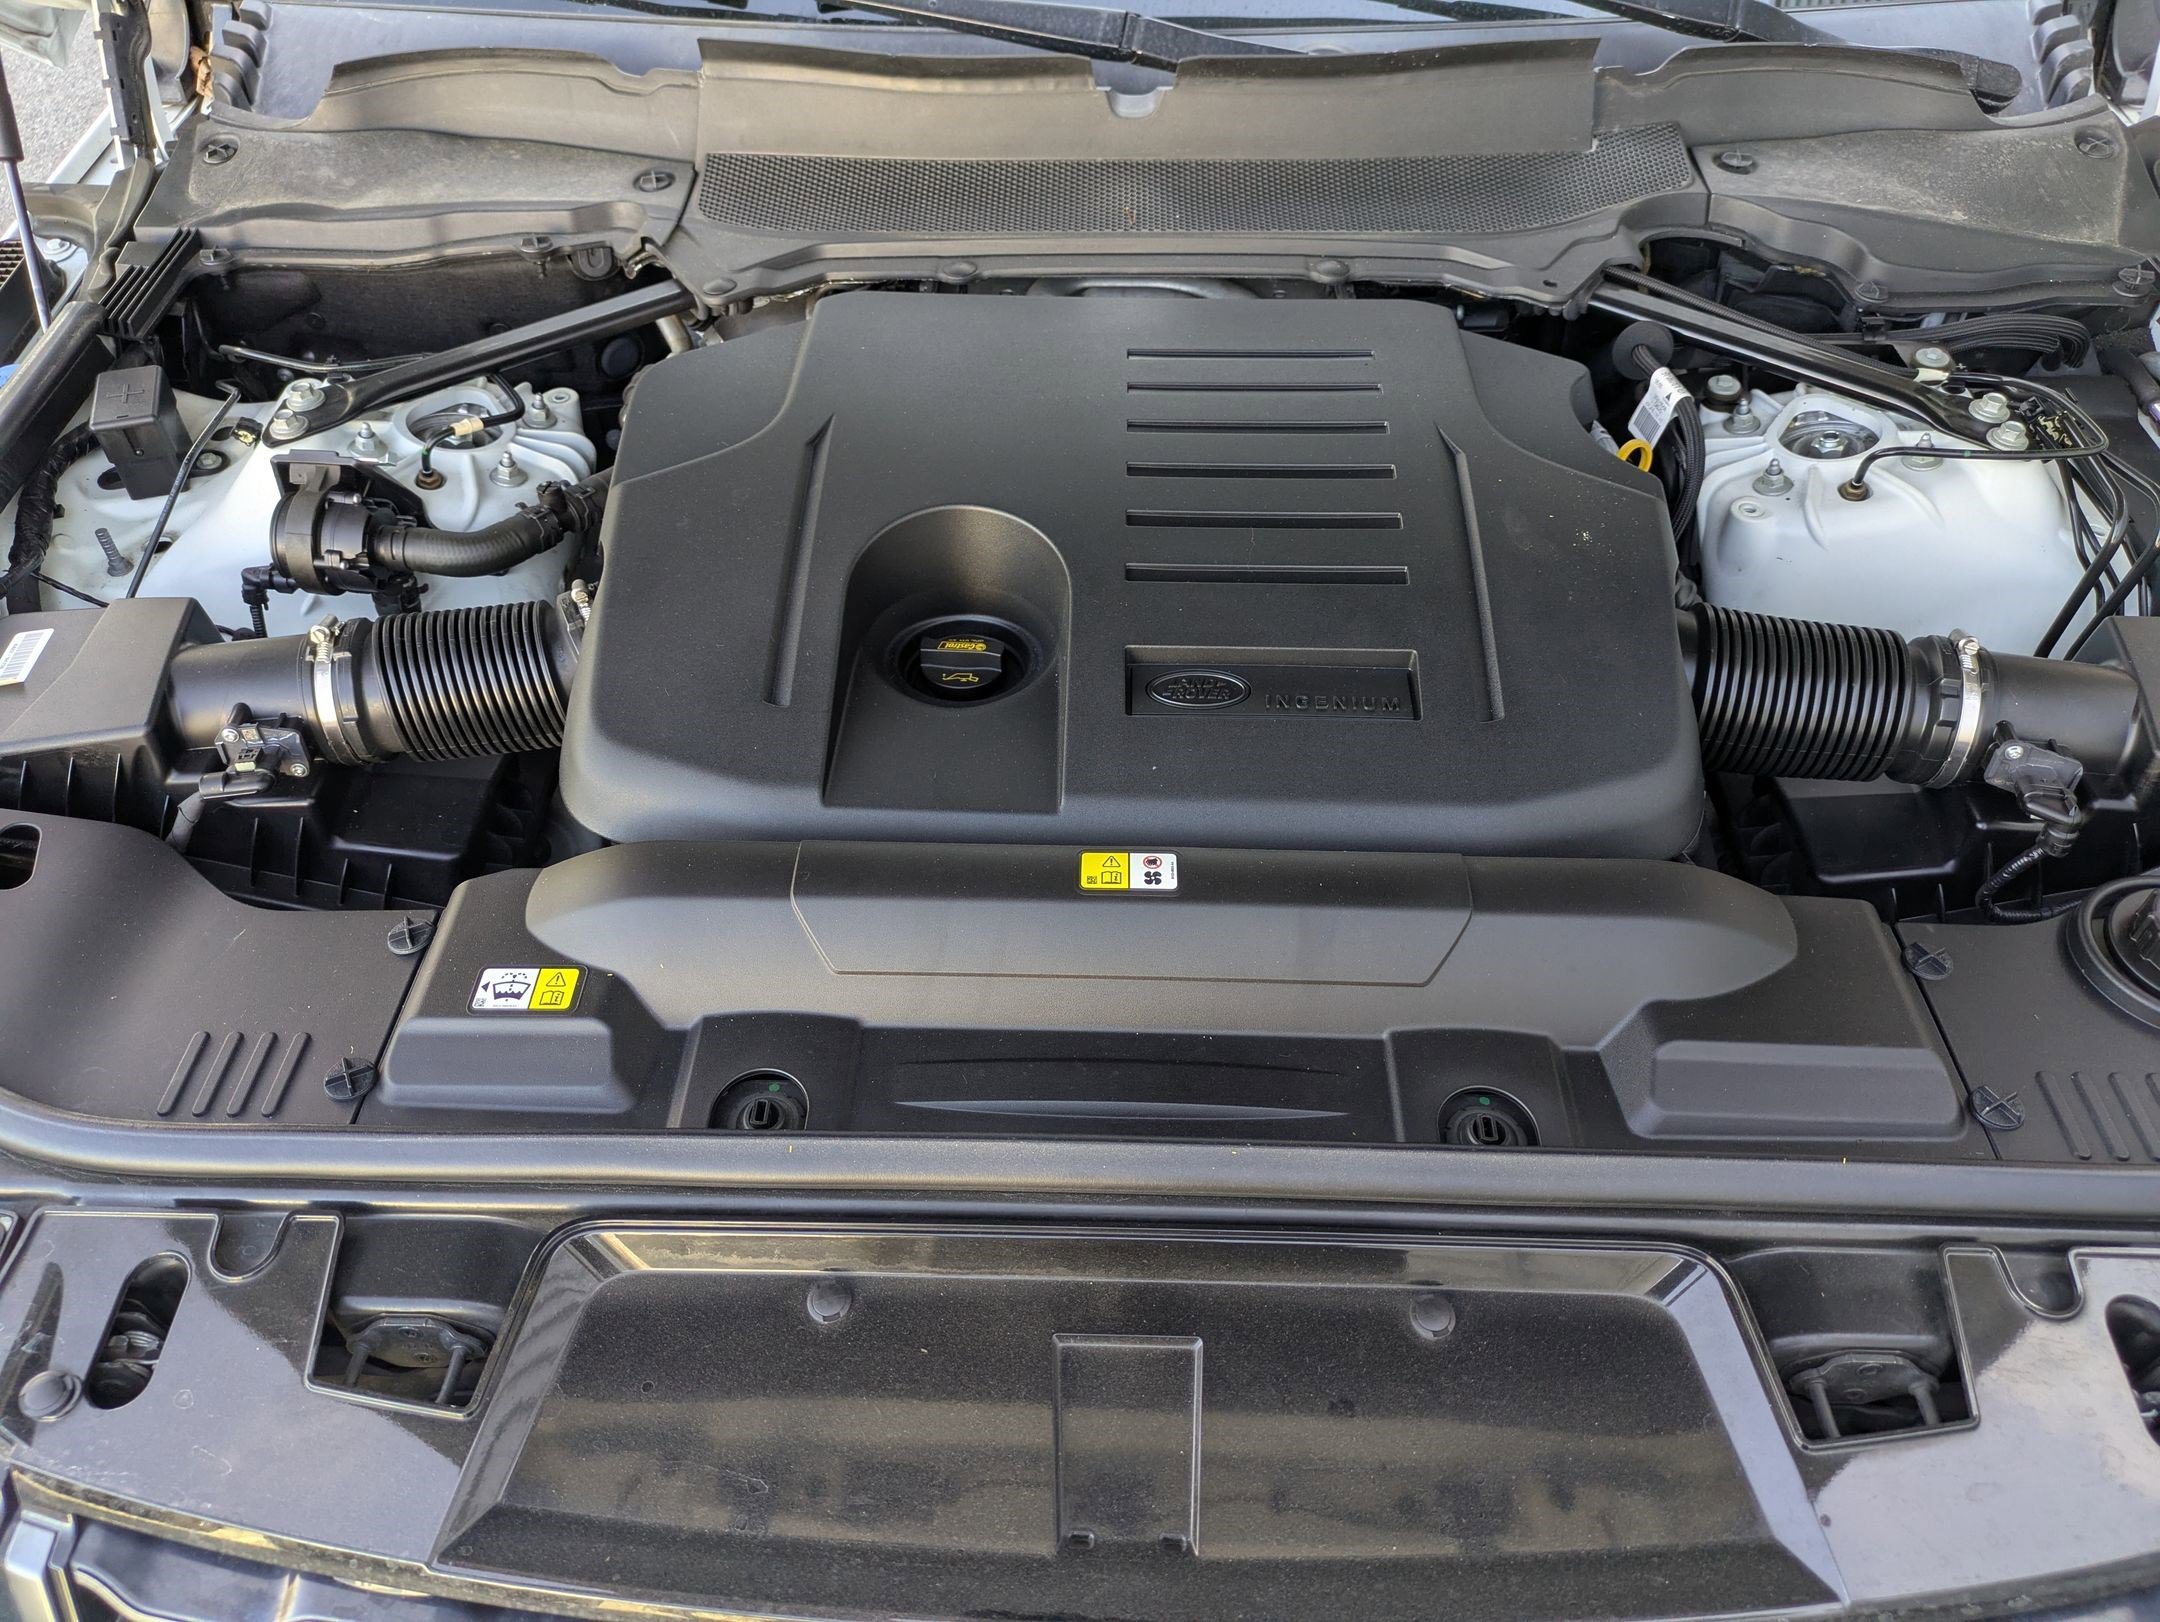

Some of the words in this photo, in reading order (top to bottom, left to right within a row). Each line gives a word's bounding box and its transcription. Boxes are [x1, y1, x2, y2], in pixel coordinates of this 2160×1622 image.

[945, 642, 976, 650] Castrol
[1172, 688, 1230, 700] ROVER
[1264, 694, 1400, 711] INGENIUM
